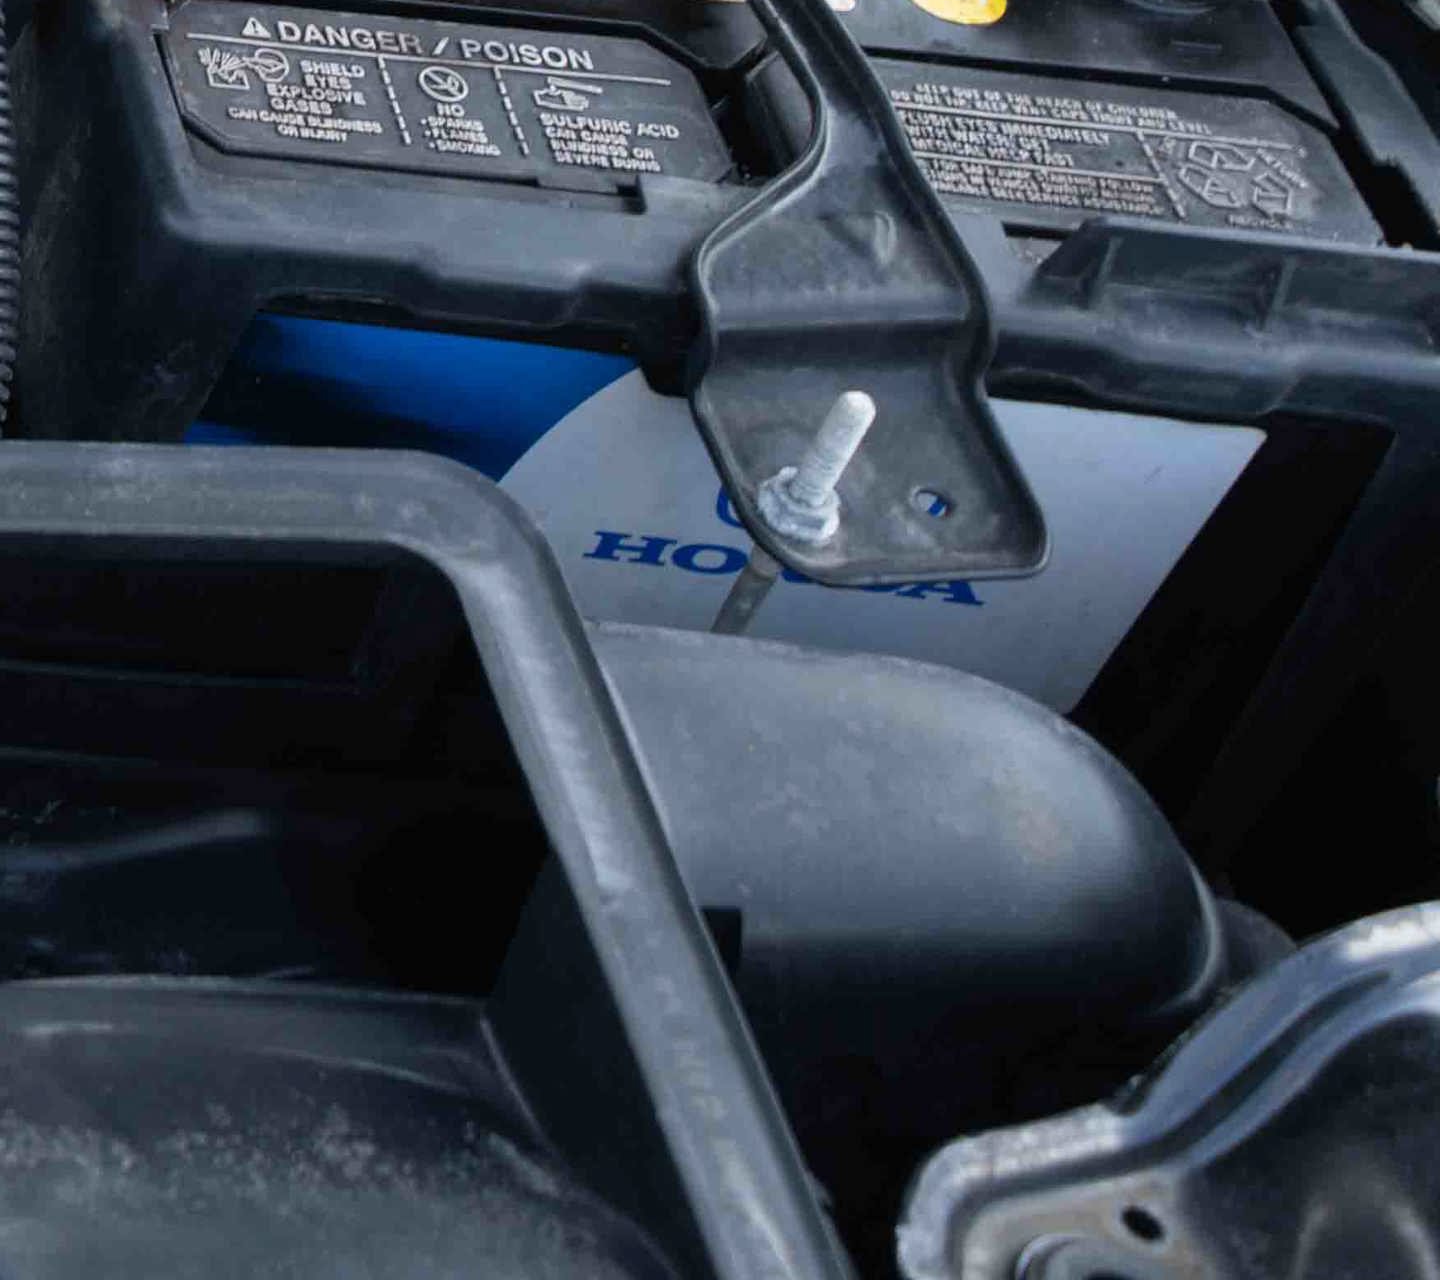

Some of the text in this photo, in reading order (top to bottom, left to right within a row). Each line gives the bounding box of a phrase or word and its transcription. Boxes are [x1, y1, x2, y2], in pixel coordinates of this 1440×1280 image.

[277, 20, 425, 55] DANGER
[460, 39, 596, 71] POISON
[300, 60, 366, 79] SHIELD
[305, 74, 353, 91] EYES
[266, 82, 367, 107] EXPLOSIVE
[270, 97, 334, 116] GASES
[437, 102, 465, 119] NO
[228, 107, 383, 134] CAN CAUSE BLINDNESS
[540, 111, 680, 140] SULFURIC ACID
[546, 127, 576, 142] CAN
[1001, 122, 1110, 146] IMMEDIATELY
[551, 139, 628, 158] BLINDNESS
